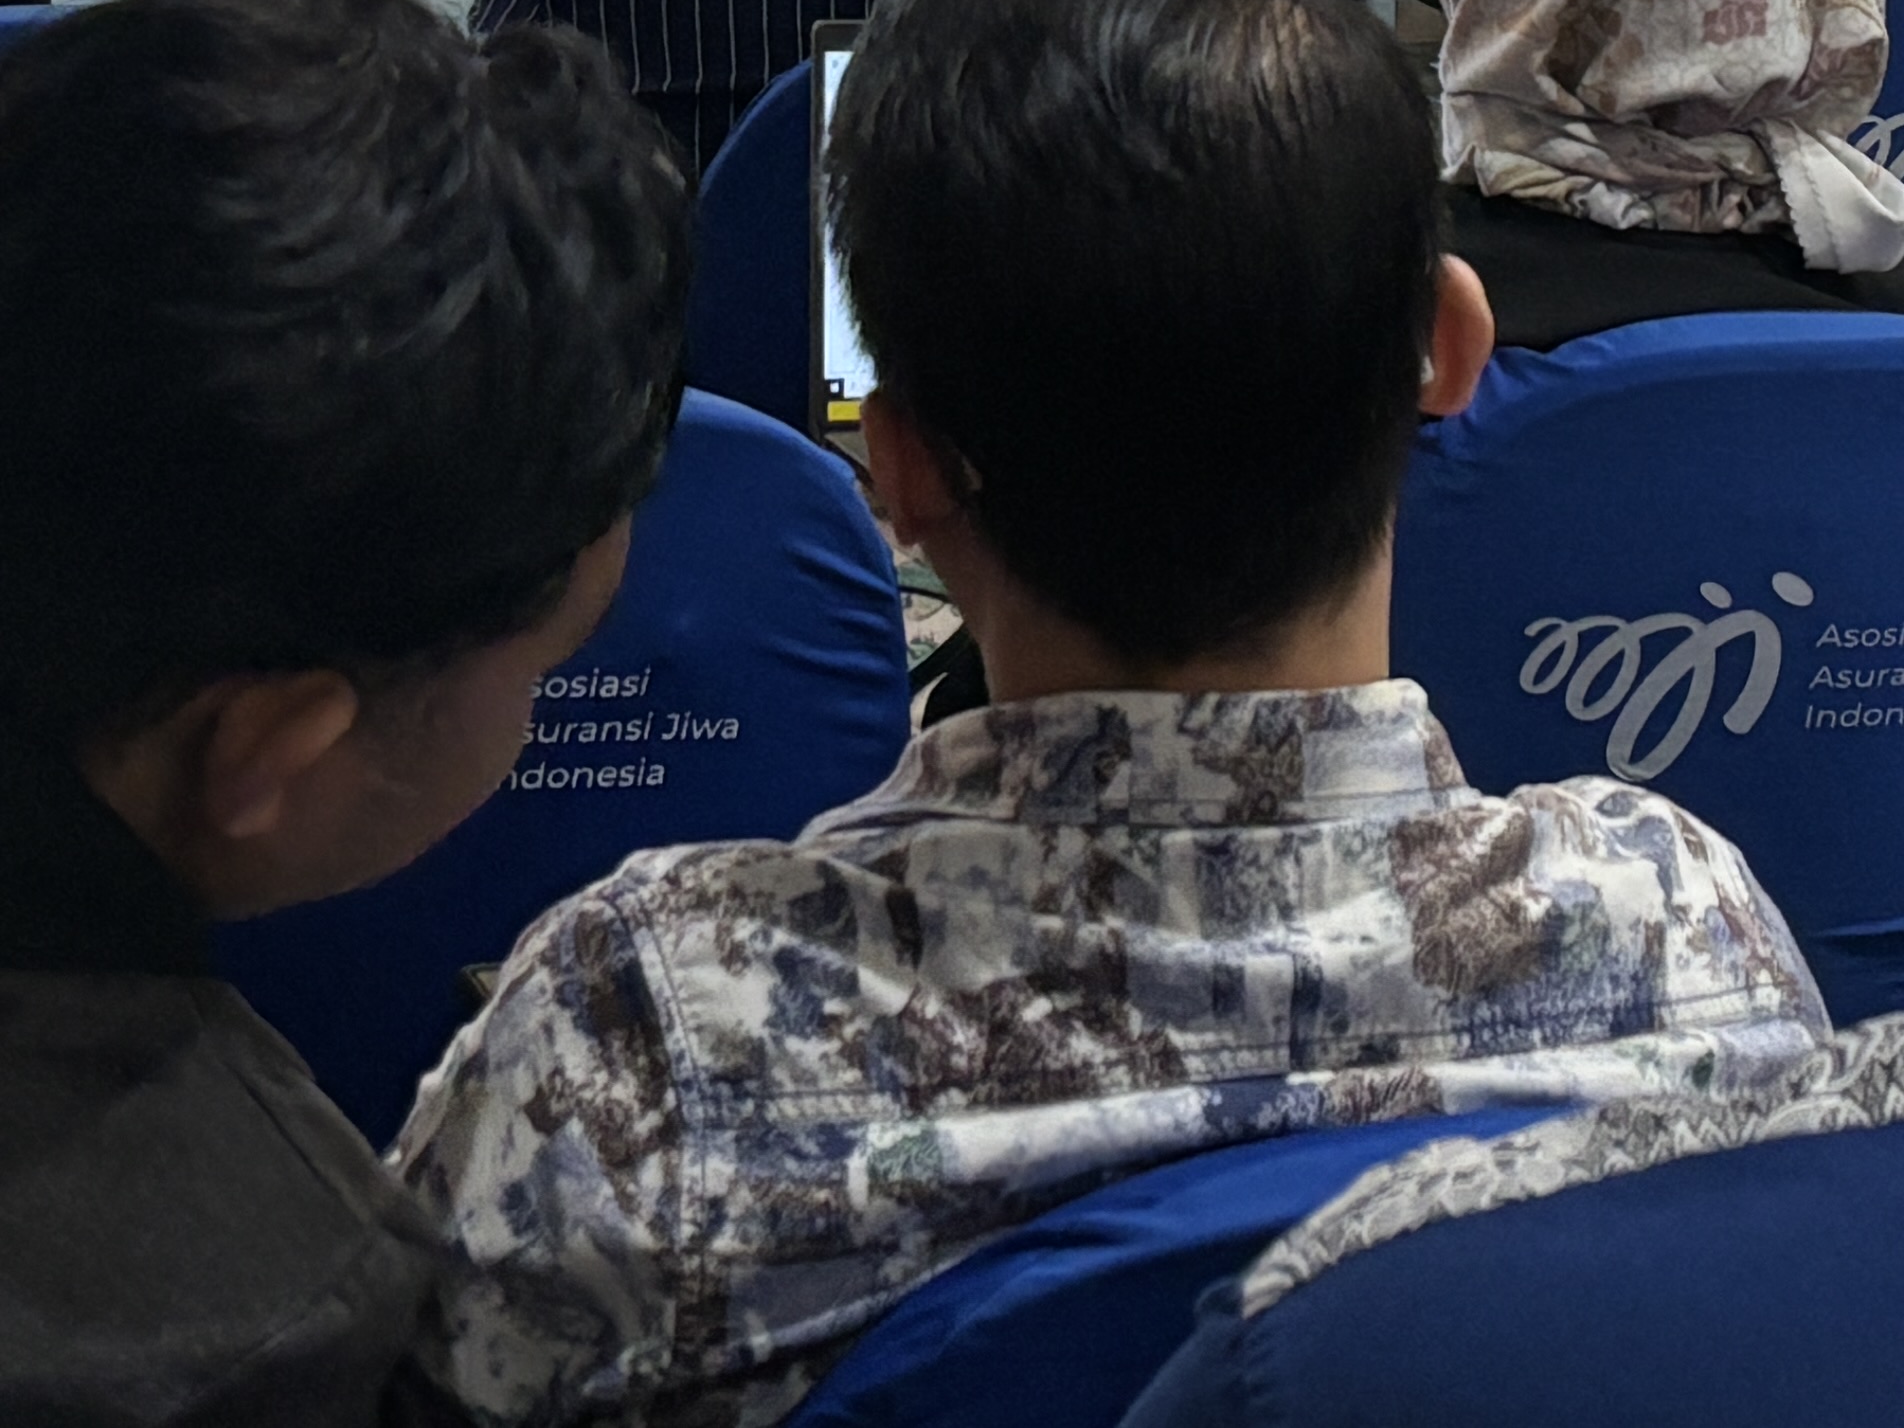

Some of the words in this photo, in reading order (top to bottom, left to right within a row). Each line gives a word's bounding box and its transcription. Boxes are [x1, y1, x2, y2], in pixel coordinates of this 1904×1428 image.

[530, 667, 651, 699] sosiasi
[521, 711, 654, 744] suransi
[662, 711, 740, 741] Jiwa
